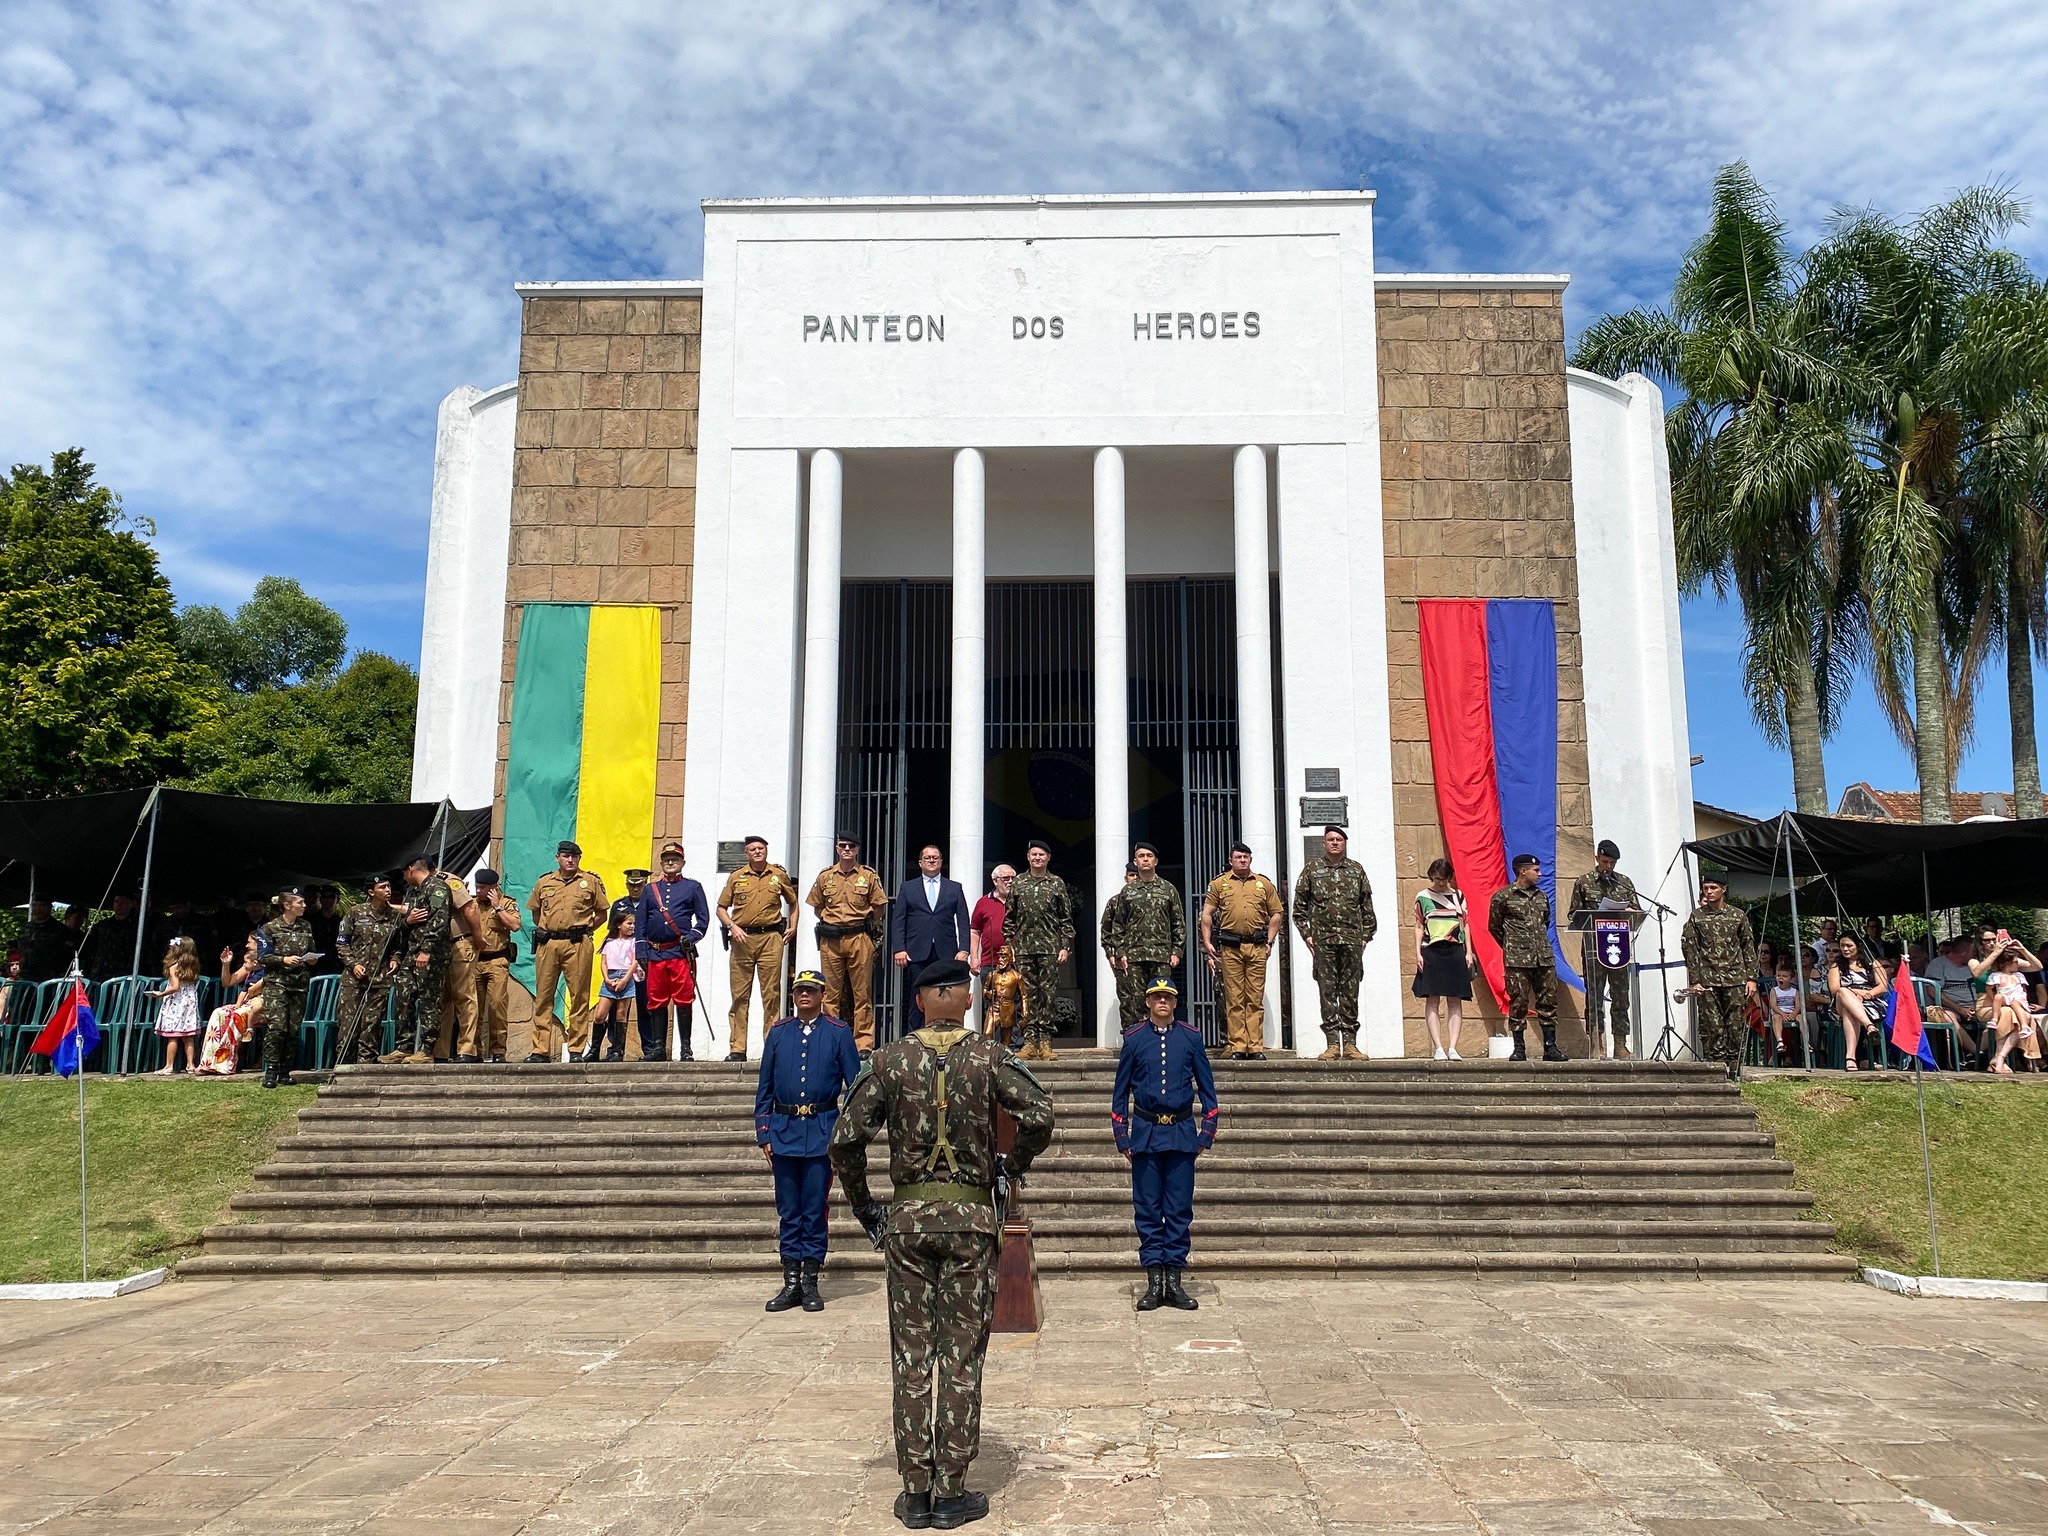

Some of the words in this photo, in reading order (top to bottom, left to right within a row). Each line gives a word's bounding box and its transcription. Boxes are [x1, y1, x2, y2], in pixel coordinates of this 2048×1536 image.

[802, 314, 945, 343] PANTEON
[1012, 315, 1065, 341] DOS
[1133, 311, 1261, 341] HEROES
